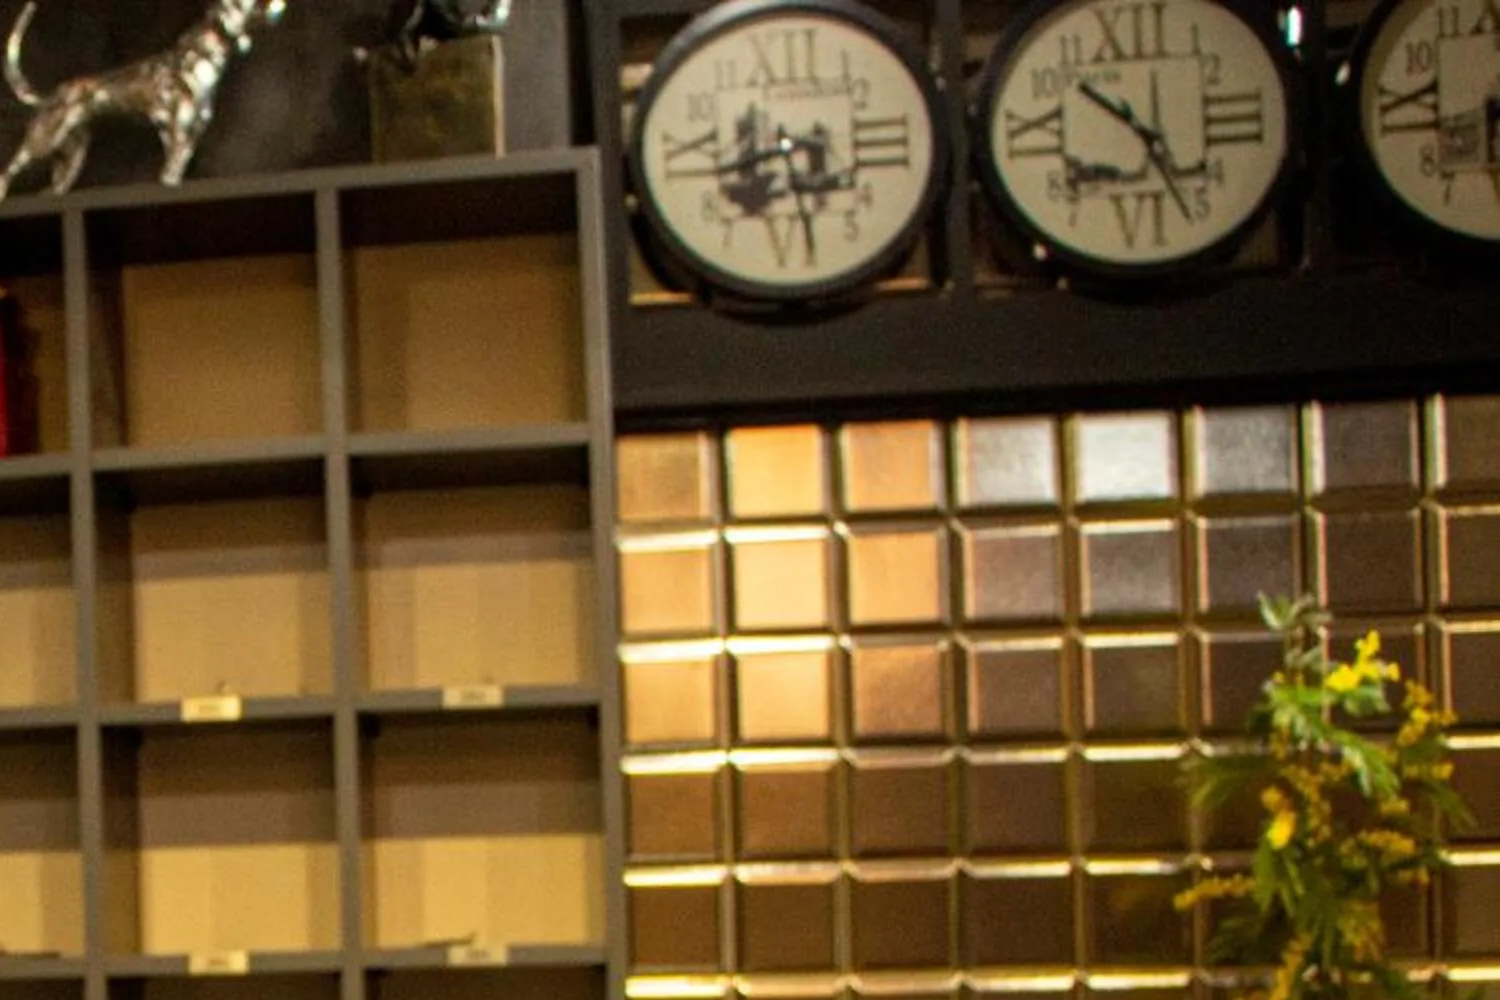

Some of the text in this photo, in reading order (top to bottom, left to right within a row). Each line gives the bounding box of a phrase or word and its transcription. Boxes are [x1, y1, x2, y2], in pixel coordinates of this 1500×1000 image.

[747, 29, 820, 90] XII
[1091, 3, 1170, 62] XII
[1404, 41, 1432, 77] 10
[1005, 105, 1064, 161] IX
[1202, 87, 1264, 148] III
[1376, 78, 1440, 138] IX
[853, 113, 911, 170] III
[1108, 189, 1170, 249] VI
